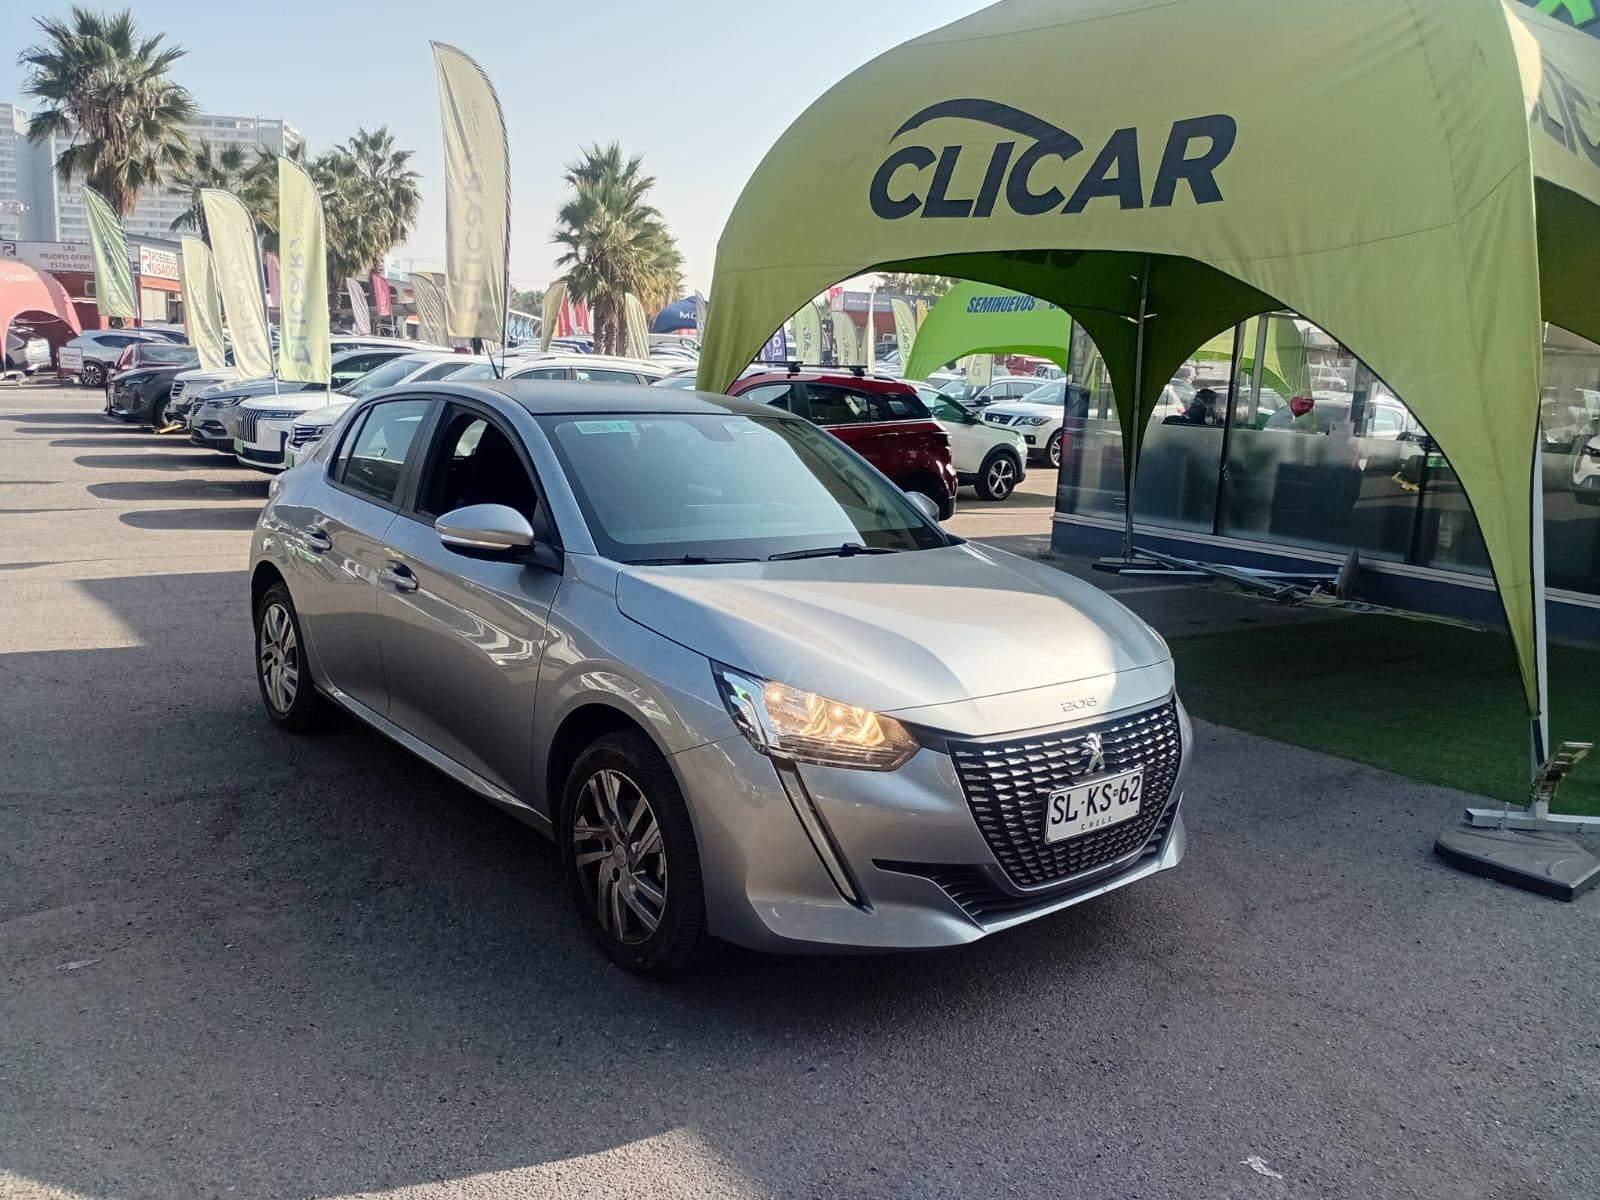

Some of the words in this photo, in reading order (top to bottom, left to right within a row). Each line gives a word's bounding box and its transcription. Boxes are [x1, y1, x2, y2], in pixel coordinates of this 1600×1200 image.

[869, 98, 1238, 220] CLICAR
[39, 253, 70, 261] MEJORES
[151, 251, 177, 266] ROSSELO
[966, 295, 1036, 314] SEMINUEVOS
[1061, 698, 1097, 712] 208
